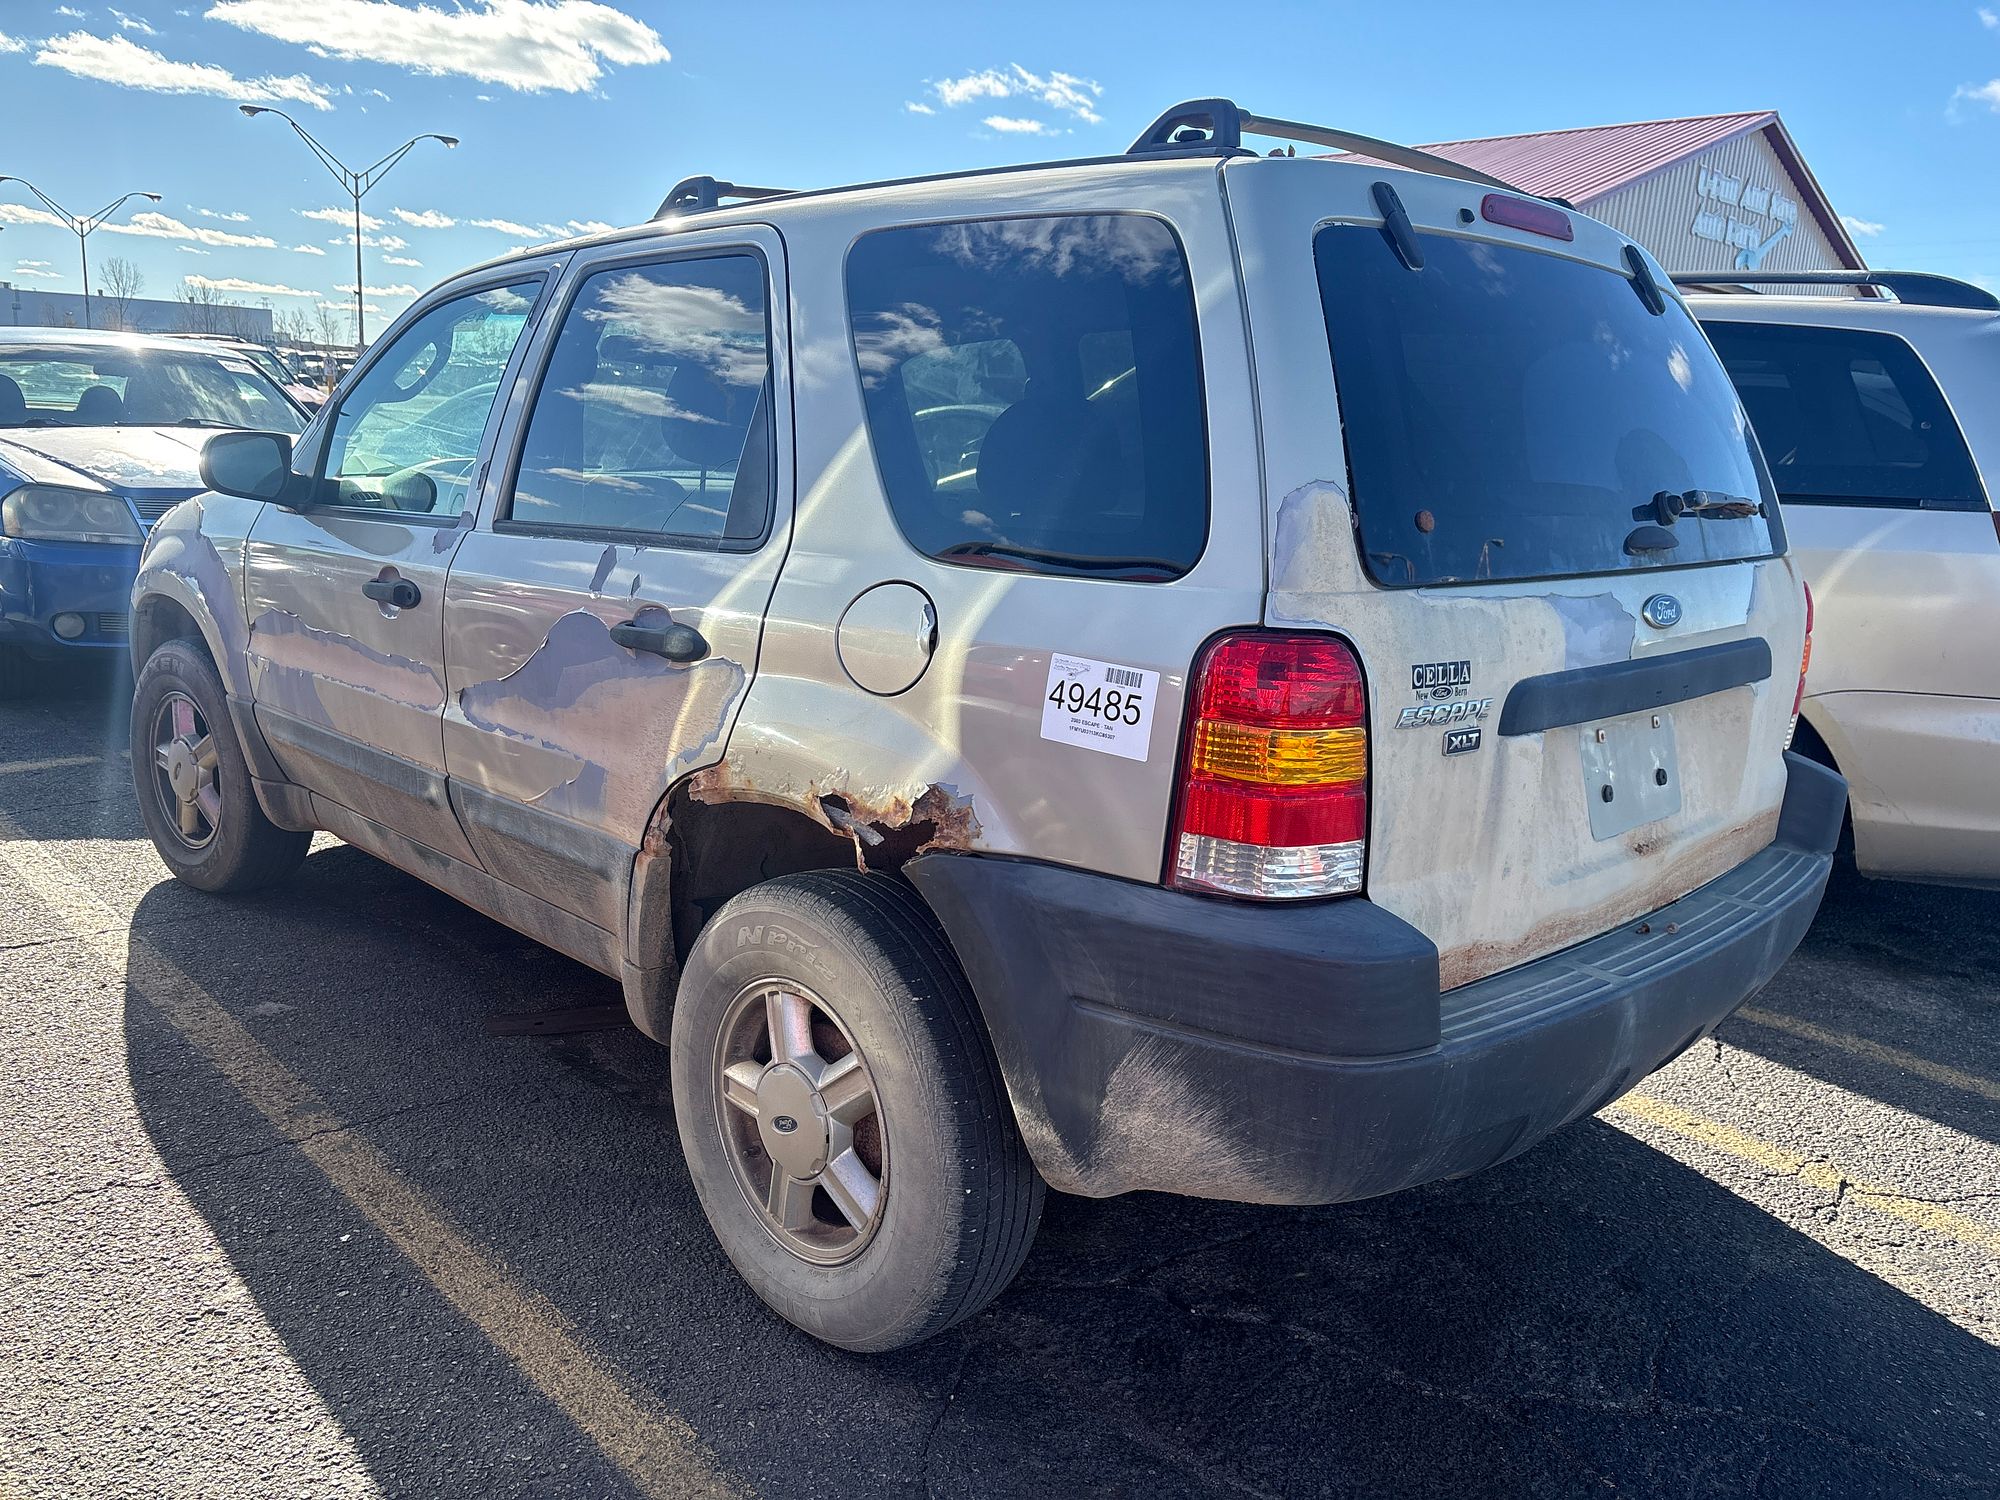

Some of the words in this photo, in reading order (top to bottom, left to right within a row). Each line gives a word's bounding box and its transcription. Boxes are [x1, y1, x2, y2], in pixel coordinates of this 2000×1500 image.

[1656, 600, 1677, 621] Ford
[1411, 661, 1471, 688] CELLA
[1048, 680, 1142, 725] 49485
[1416, 691, 1429, 701] New
[1454, 686, 1468, 696] Bern
[1081, 719, 1100, 728] ESCAPE
[1395, 698, 1495, 729] ESCAPE
[1449, 733, 1479, 750] XLT
